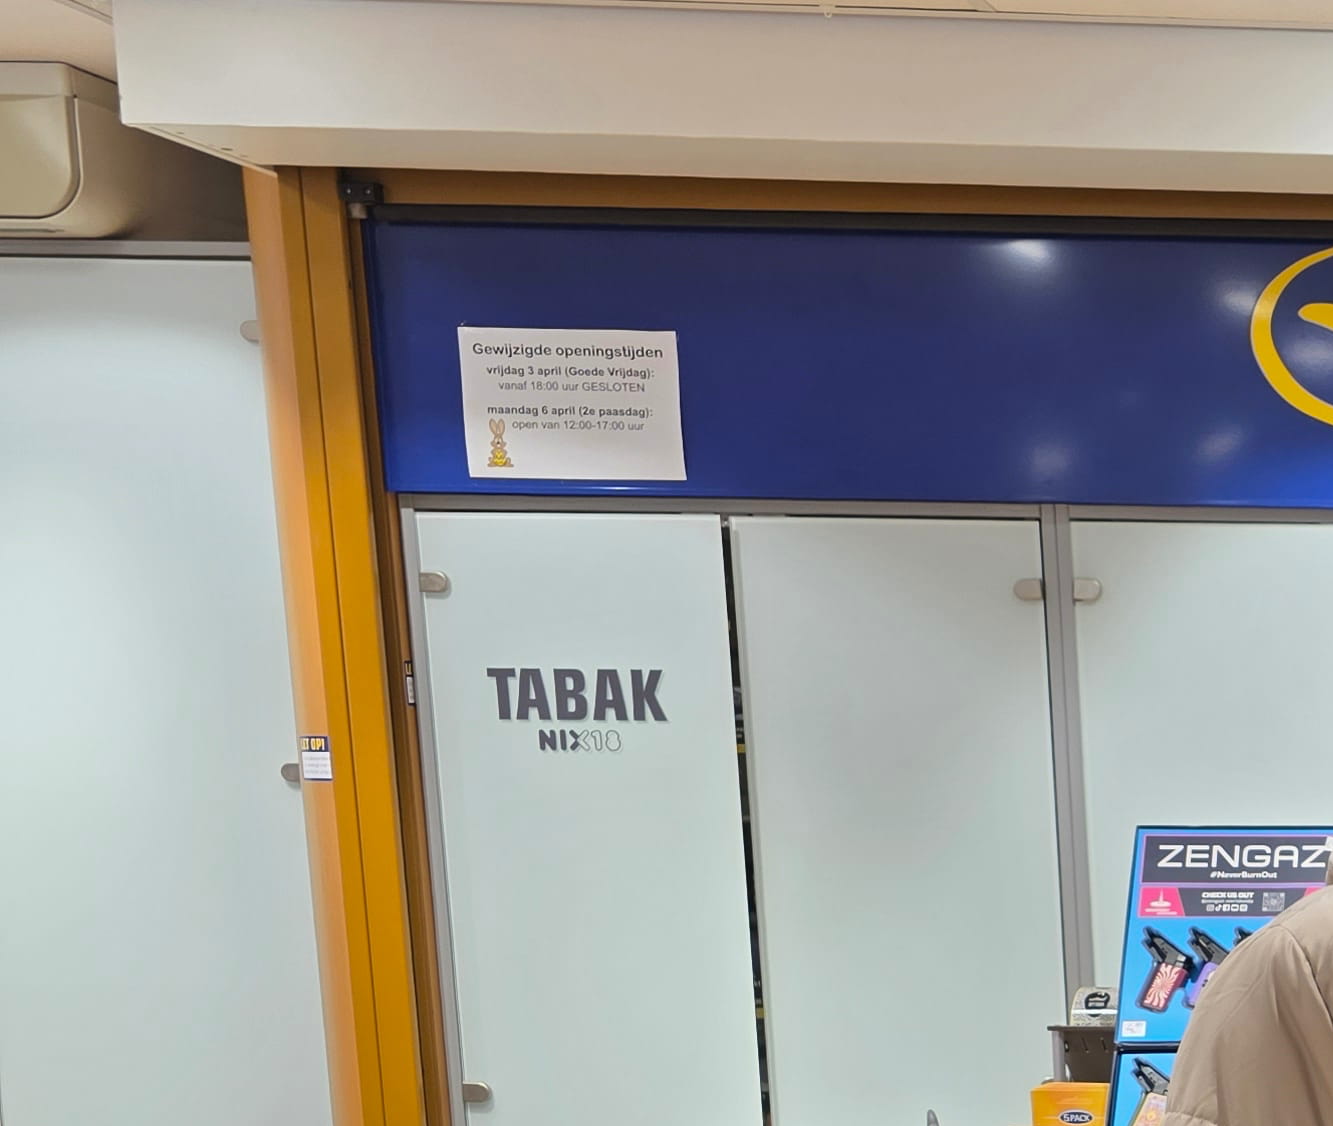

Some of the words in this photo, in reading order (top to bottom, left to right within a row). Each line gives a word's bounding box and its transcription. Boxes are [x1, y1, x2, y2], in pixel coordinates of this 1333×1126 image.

[472, 342, 552, 358] Gewijzigde
[555, 343, 664, 361] openingstijden
[486, 366, 525, 377] vrijdag
[527, 366, 535, 376] 3
[537, 366, 562, 378] april
[565, 367, 605, 378] (Goede
[607, 368, 655, 380] Vrijdag):
[498, 381, 527, 391] vanaf
[531, 381, 559, 391] 18:00
[561, 383, 579, 391] uur
[582, 382, 645, 393] GESLOTEN
[487, 406, 539, 416] maandag
[541, 406, 548, 415] 6
[551, 405, 576, 417] april
[578, 406, 596, 417] (2e
[598, 407, 654, 418] paasdag):
[511, 421, 538, 431] open
[541, 422, 560, 430] van
[563, 421, 626, 431] 12:00-17:00
[627, 422, 644, 431] uur
[487, 667, 668, 722] TABAK
[538, 728, 623, 752] NIX18
[1157, 844, 1332, 868] ZENGAZ
